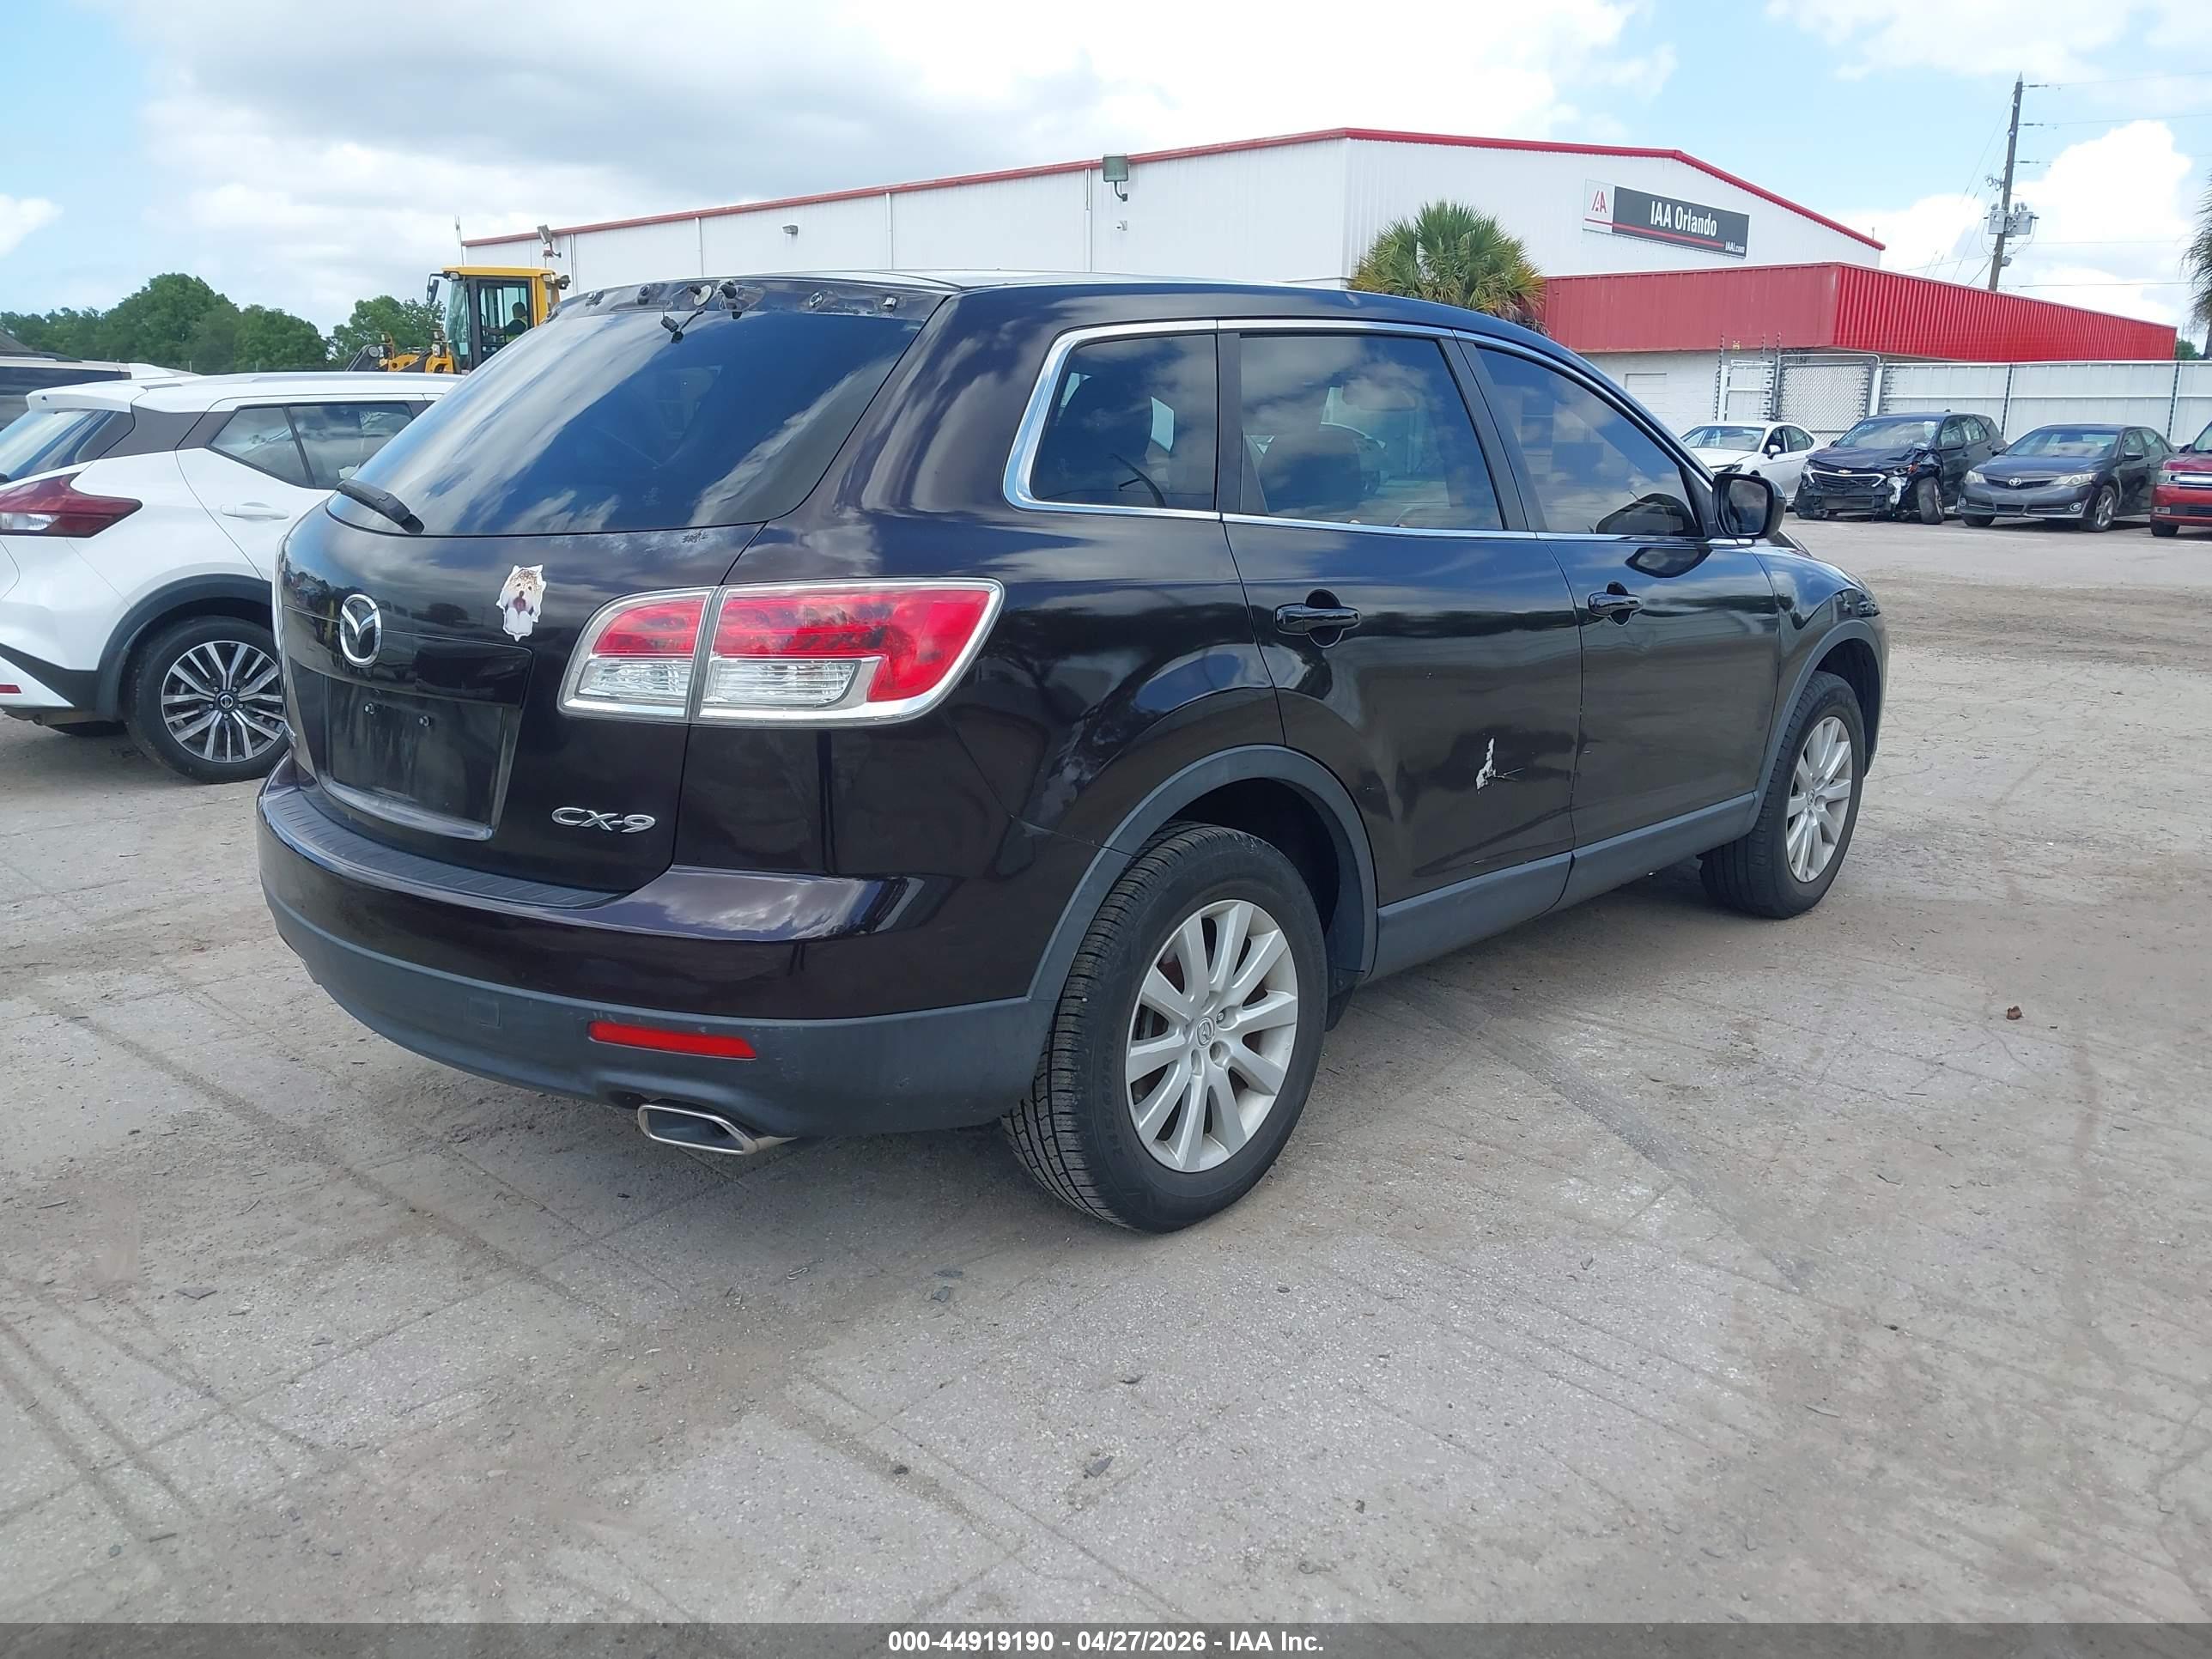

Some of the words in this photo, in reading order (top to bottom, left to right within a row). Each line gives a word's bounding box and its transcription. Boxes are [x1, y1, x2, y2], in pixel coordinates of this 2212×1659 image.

[1650, 201, 1671, 228] IAA
[1675, 206, 1717, 236] Orlando
[551, 806, 656, 834] CX-9
